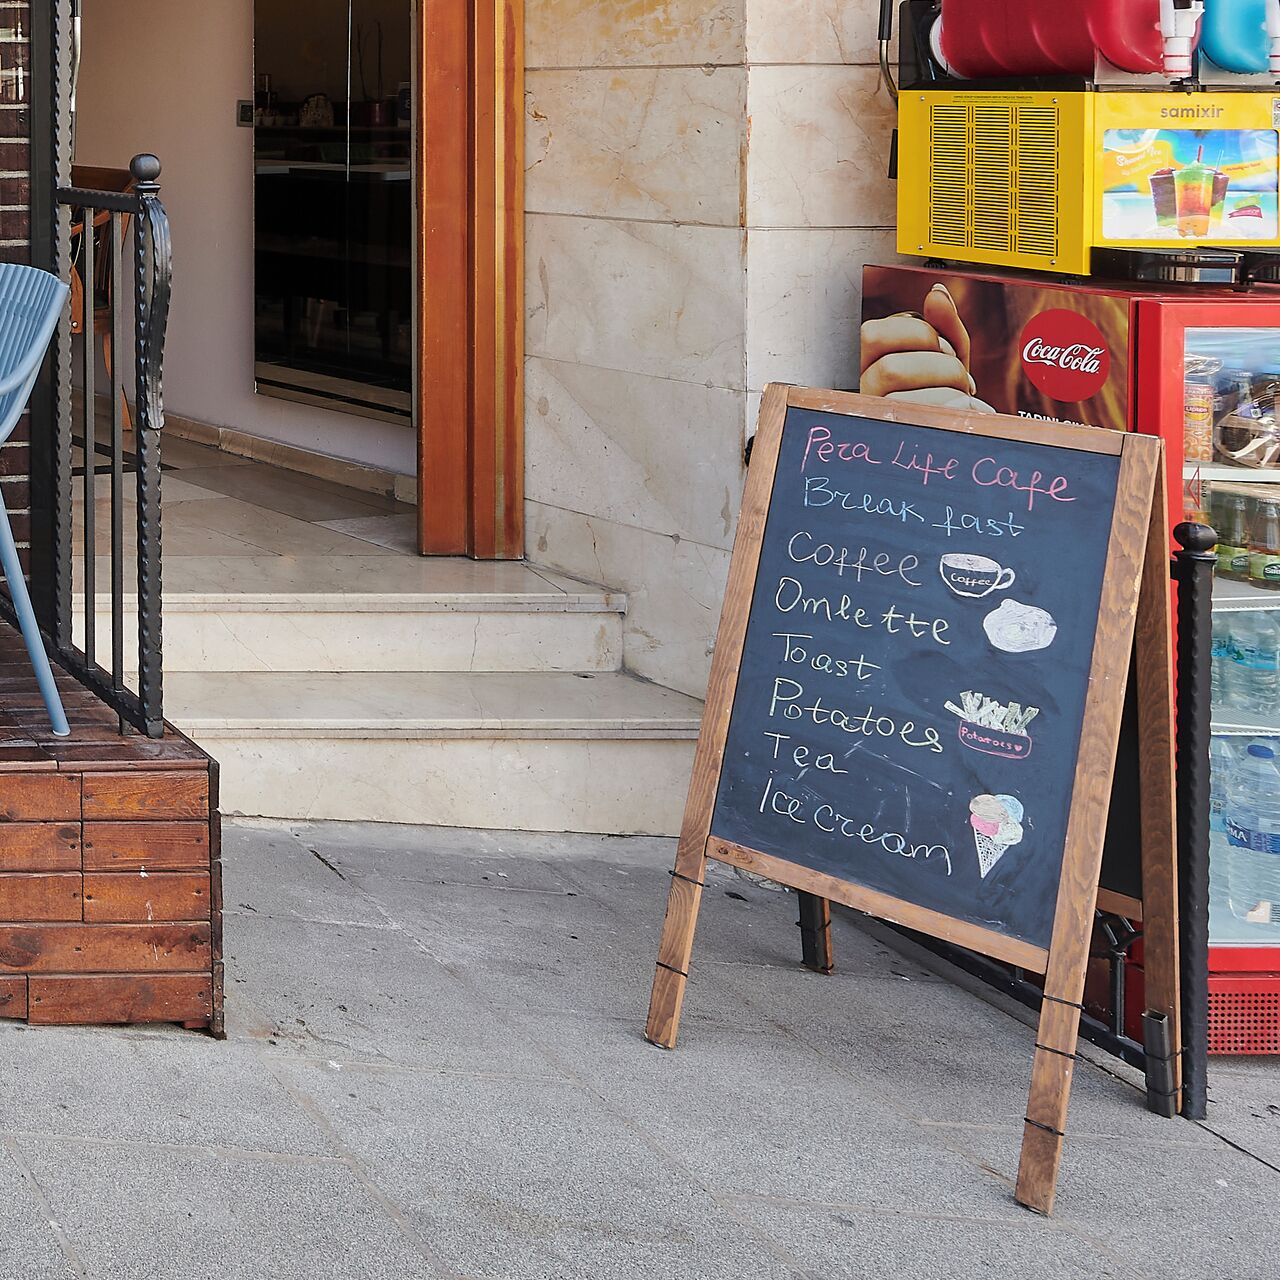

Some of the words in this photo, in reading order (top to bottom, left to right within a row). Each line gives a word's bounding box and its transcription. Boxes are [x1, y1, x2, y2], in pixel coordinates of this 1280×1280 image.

[1160, 104, 1224, 118] samixir
[1023, 337, 1105, 374] Coca-Cola
[800, 427, 882, 473] Pera
[891, 441, 960, 485] Life
[972, 458, 1078, 511] Cafe
[788, 531, 922, 586] Coffee
[950, 572, 993, 587] Coffee
[772, 633, 882, 680] Toast
[769, 677, 943, 753] Potatoes
[763, 731, 848, 774] Tea
